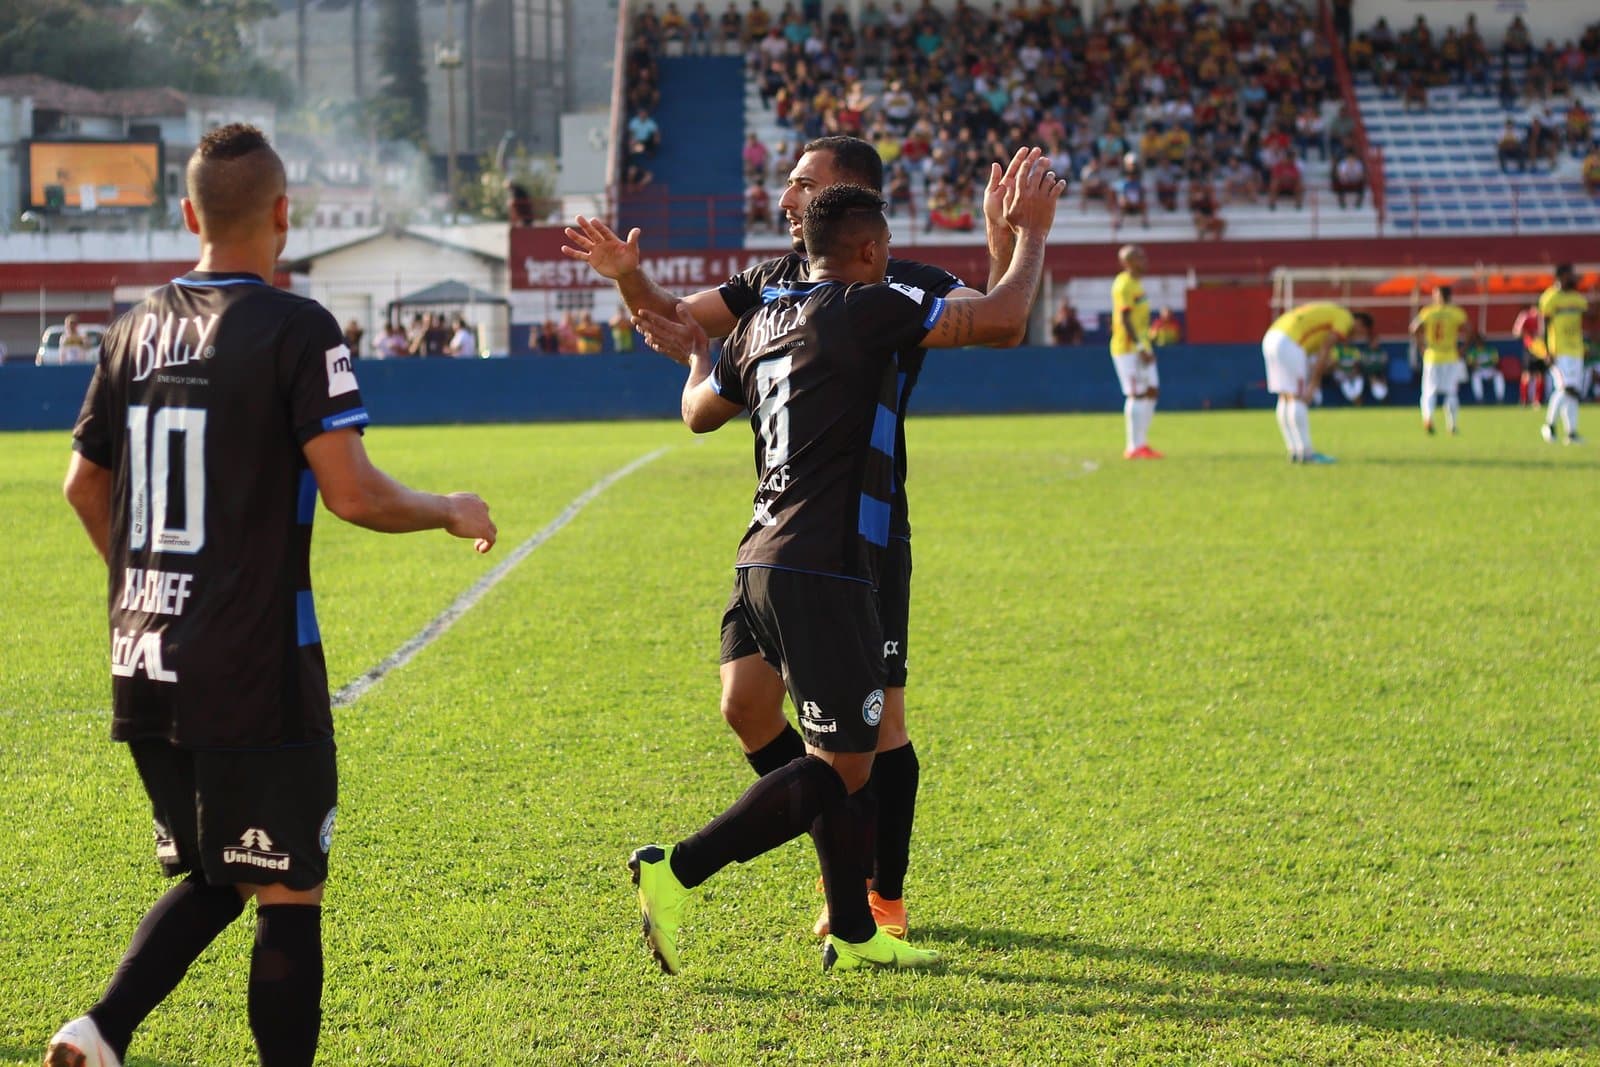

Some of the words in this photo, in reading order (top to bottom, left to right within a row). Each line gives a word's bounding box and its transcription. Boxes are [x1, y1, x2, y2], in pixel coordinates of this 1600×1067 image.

[525, 257, 706, 286] RESTAANTE
[132, 311, 220, 382] BALY
[127, 405, 207, 554] 10
[223, 850, 290, 871] Unimed
